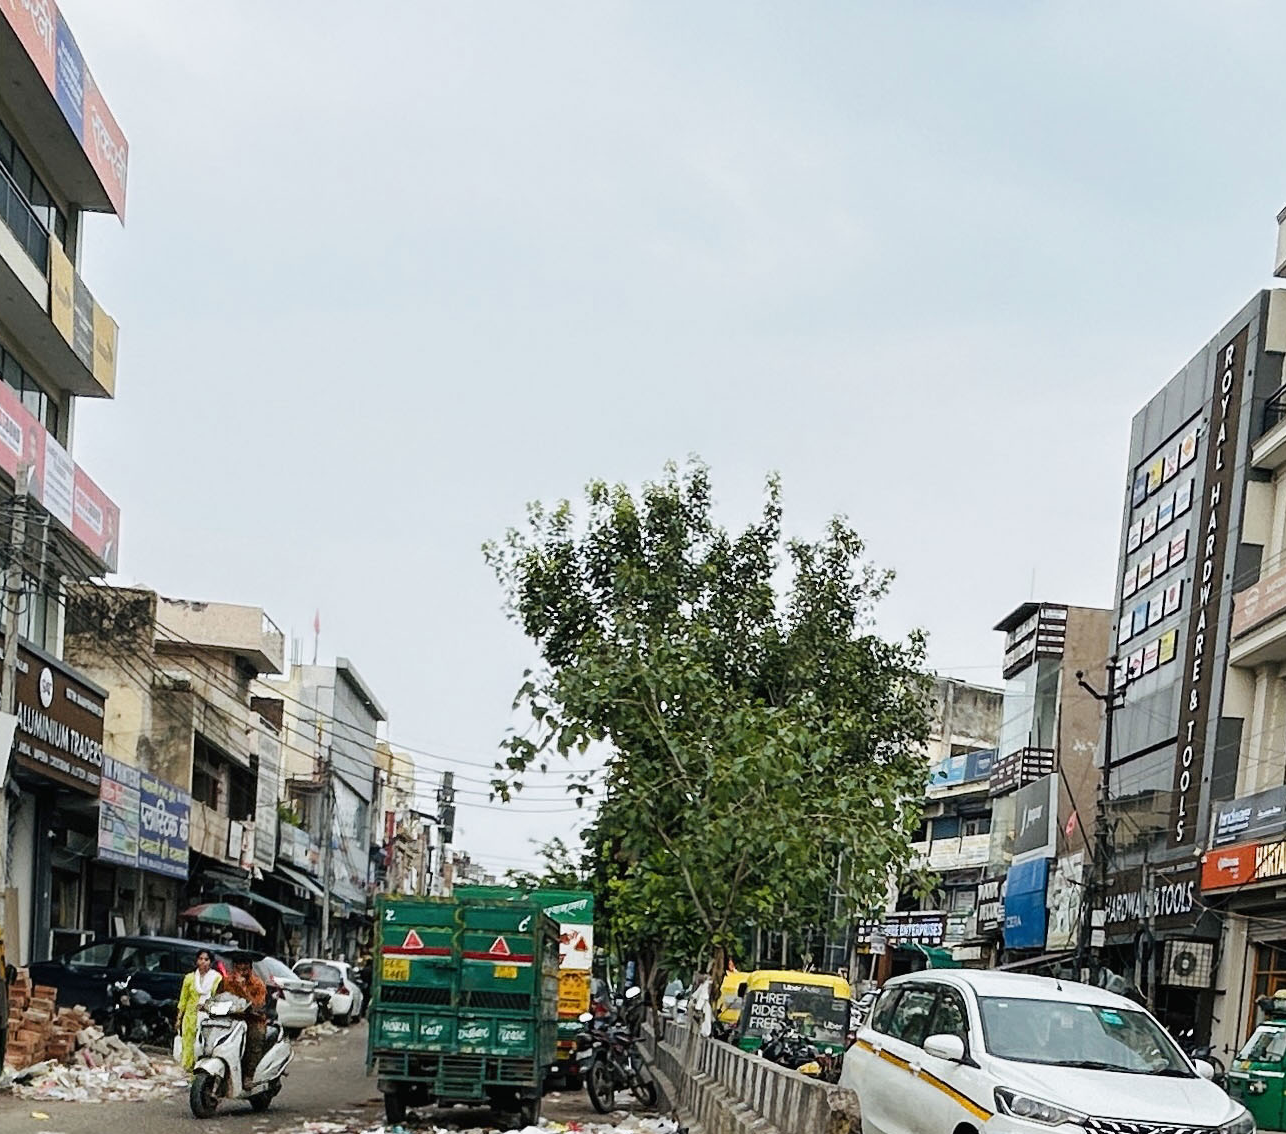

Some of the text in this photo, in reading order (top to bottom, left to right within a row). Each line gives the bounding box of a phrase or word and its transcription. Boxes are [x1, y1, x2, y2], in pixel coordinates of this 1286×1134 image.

[1175, 343, 1235, 843] ROYAL HARDWARE & TOOLS
[1160, 880, 1196, 916] TOOLS
[751, 1003, 786, 1018] RIDES
[823, 1020, 844, 1031] Uber
